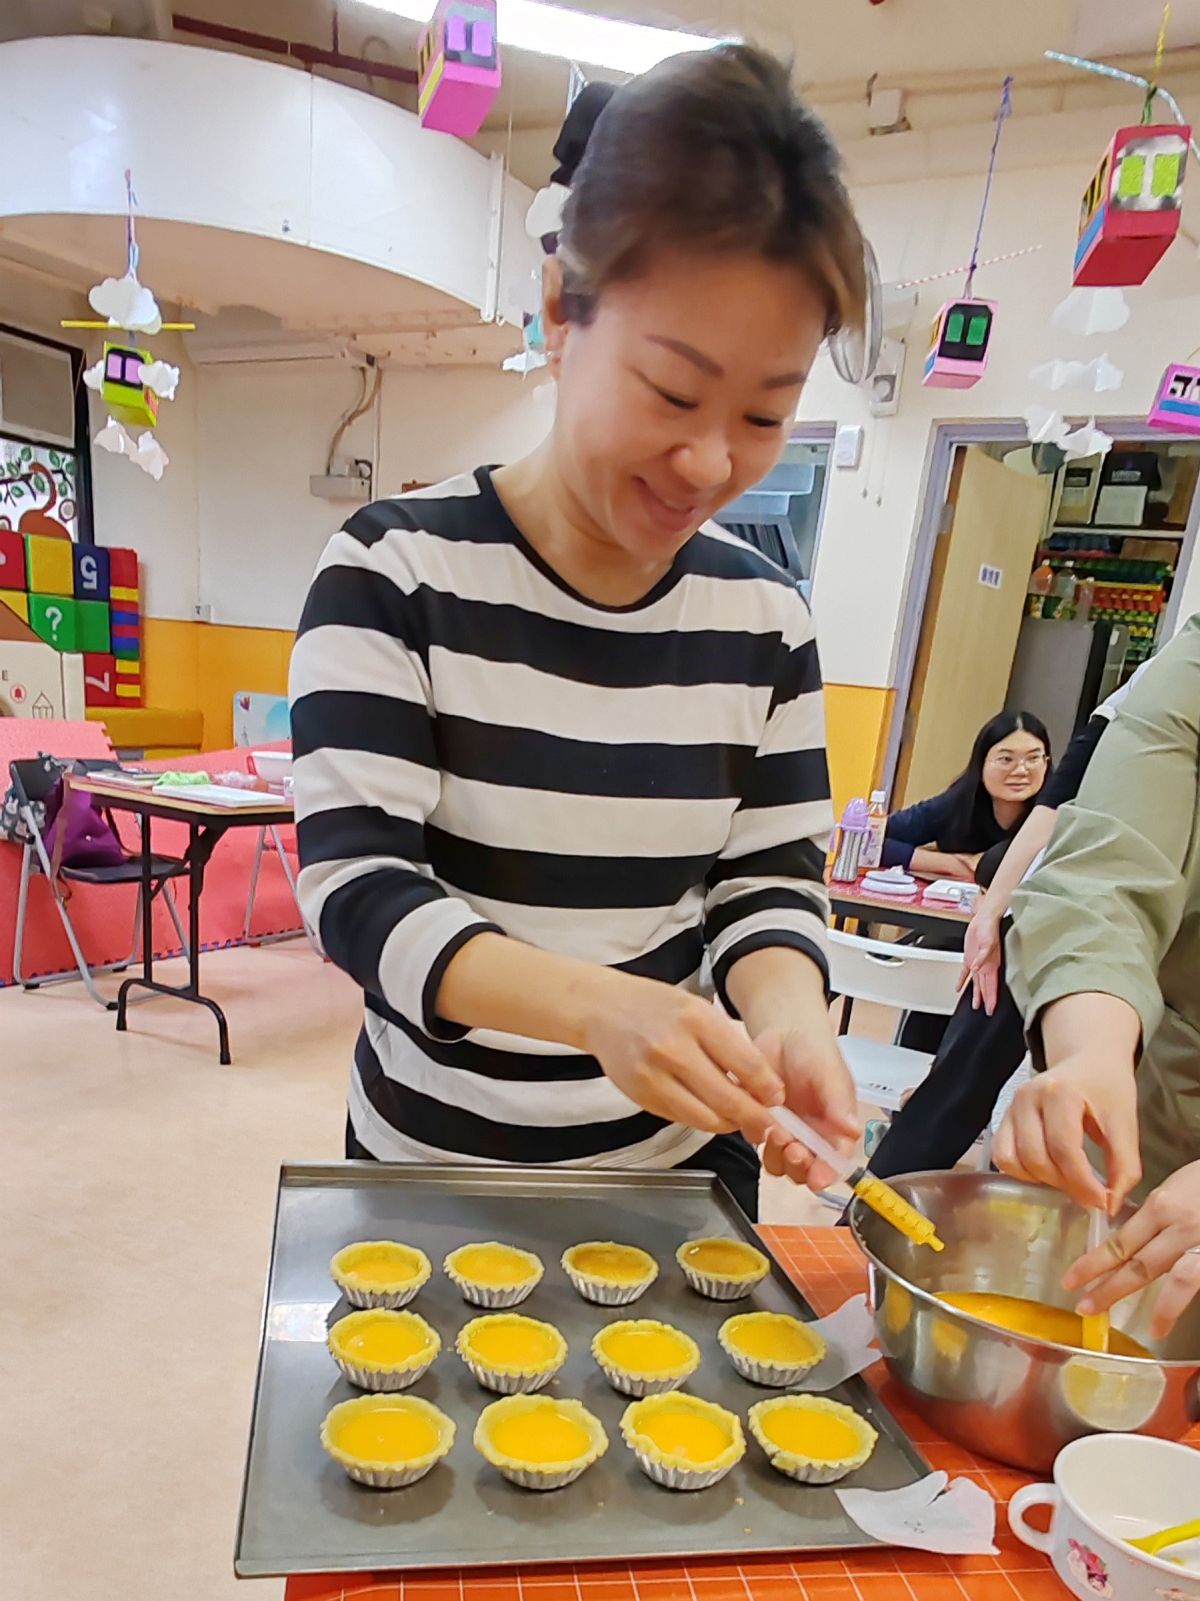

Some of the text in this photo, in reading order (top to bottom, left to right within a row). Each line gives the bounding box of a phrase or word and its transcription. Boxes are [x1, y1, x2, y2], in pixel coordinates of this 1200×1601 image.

[80, 555, 98, 590] 5
[45, 606, 63, 642] ?
[85, 672, 110, 692] 7
